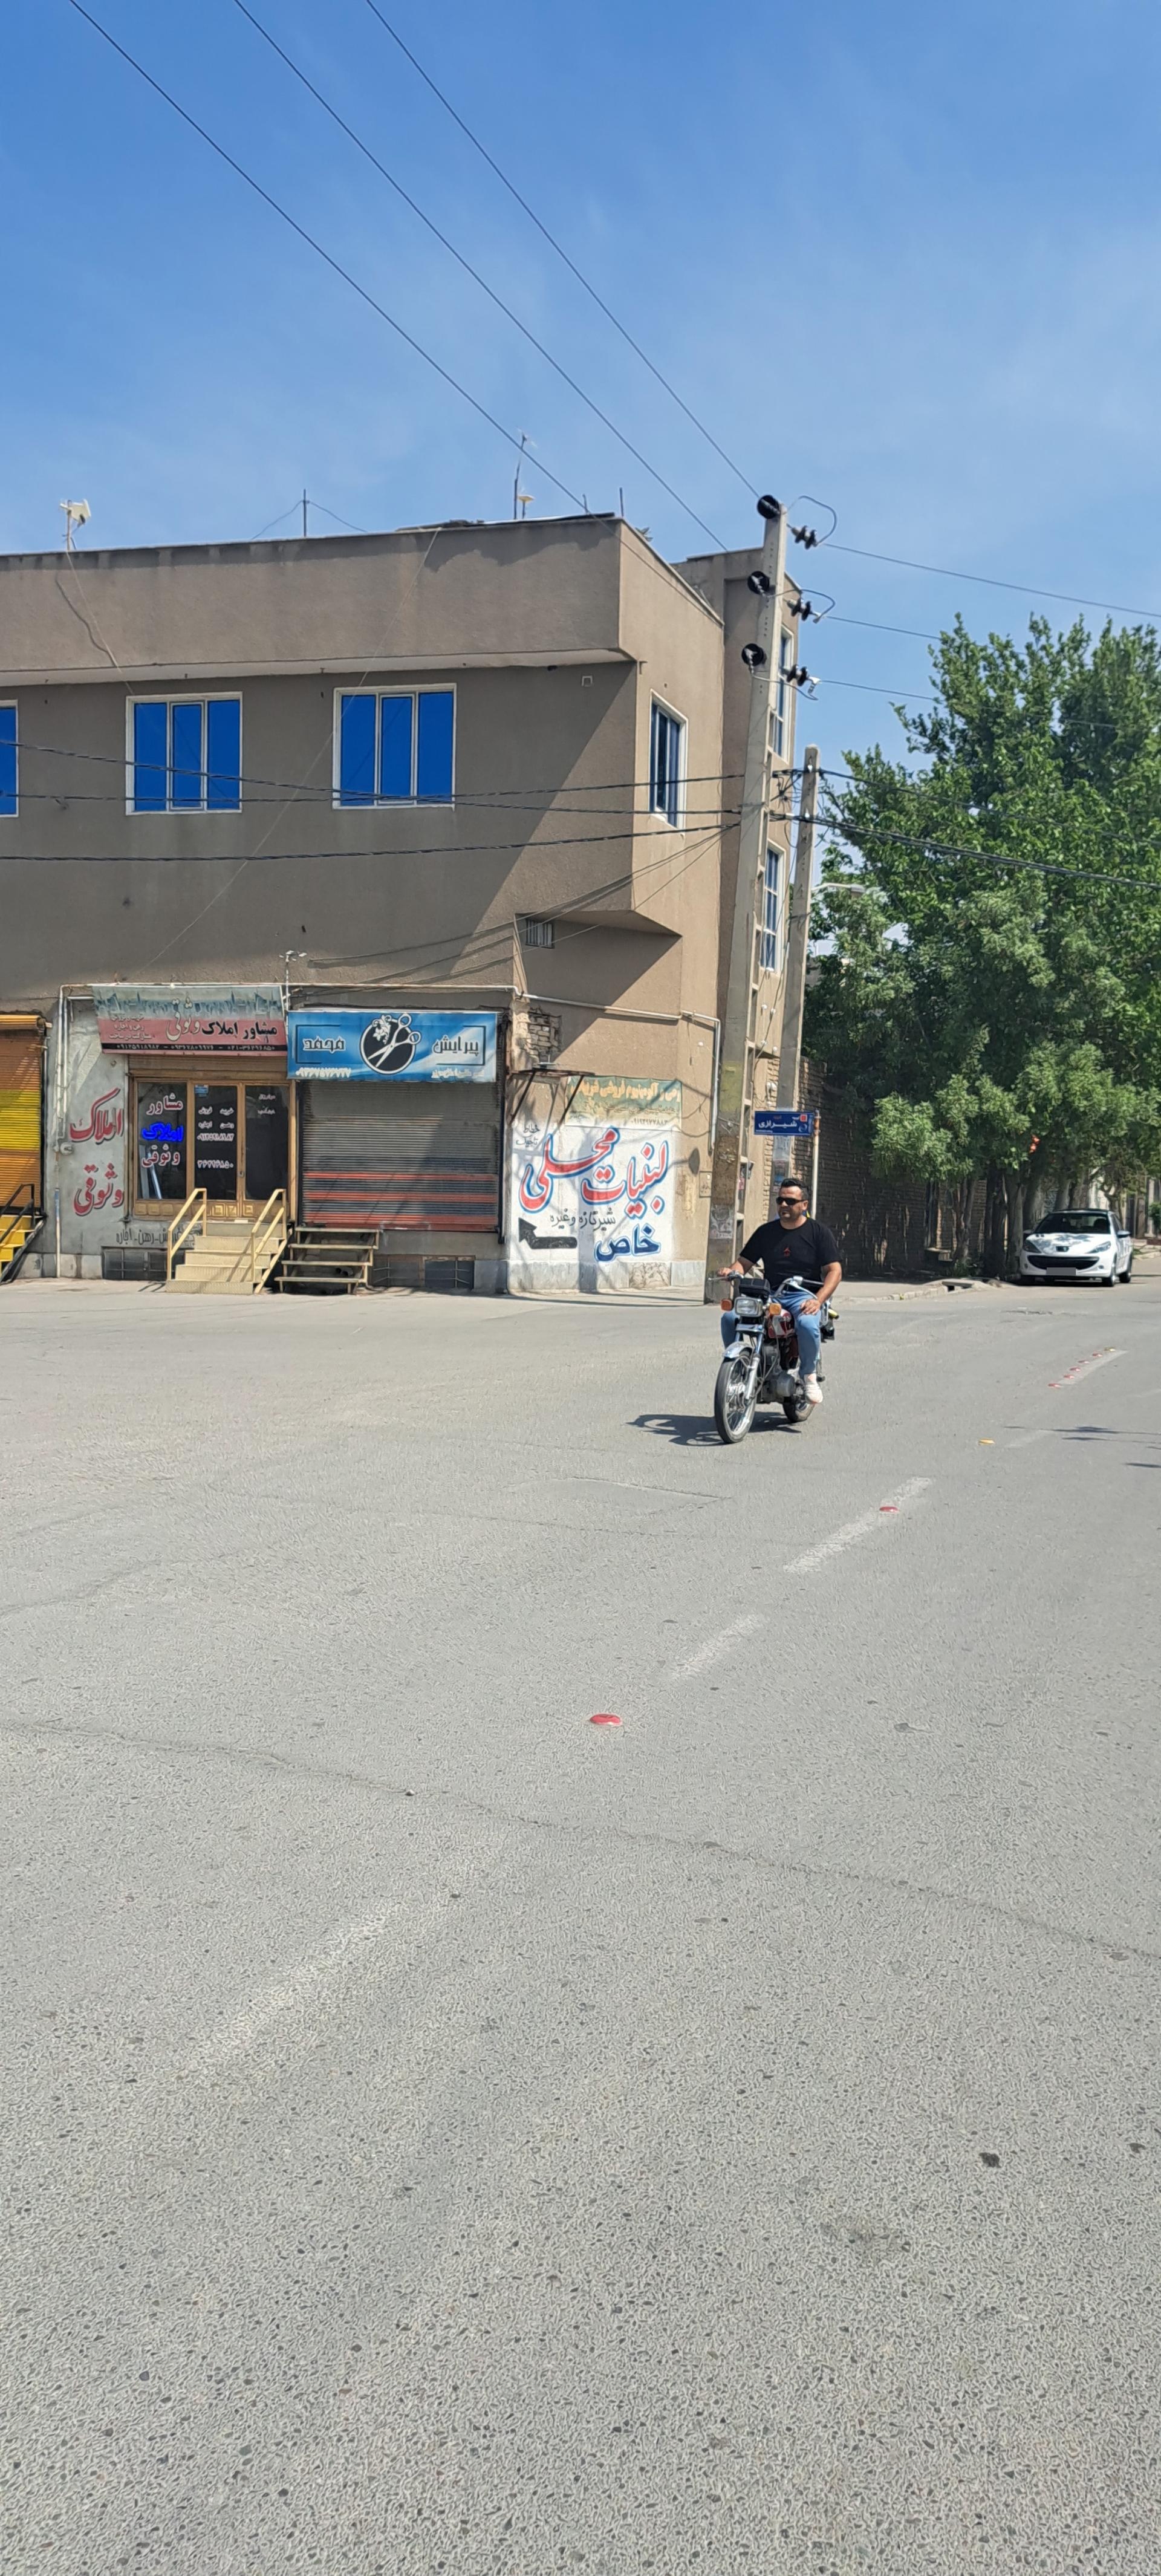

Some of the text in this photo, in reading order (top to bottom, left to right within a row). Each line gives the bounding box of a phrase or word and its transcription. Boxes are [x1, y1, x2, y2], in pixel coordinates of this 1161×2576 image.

[201, 1020, 239, 1036] املاک
[242, 1021, 278, 1039] مشاور
[303, 1035, 479, 1056] پیرایش محمد
[146, 1093, 183, 1115] مشاور
[70, 1087, 123, 1144] املاک
[758, 1119, 797, 1129] شیرازی
[141, 1143, 181, 1168] وثوقی
[519, 1125, 670, 1219] لبنیات محلی
[74, 1162, 124, 1216] وثوقی
[116, 1228, 132, 1245] اجاره
[594, 1223, 662, 1263] خاص
